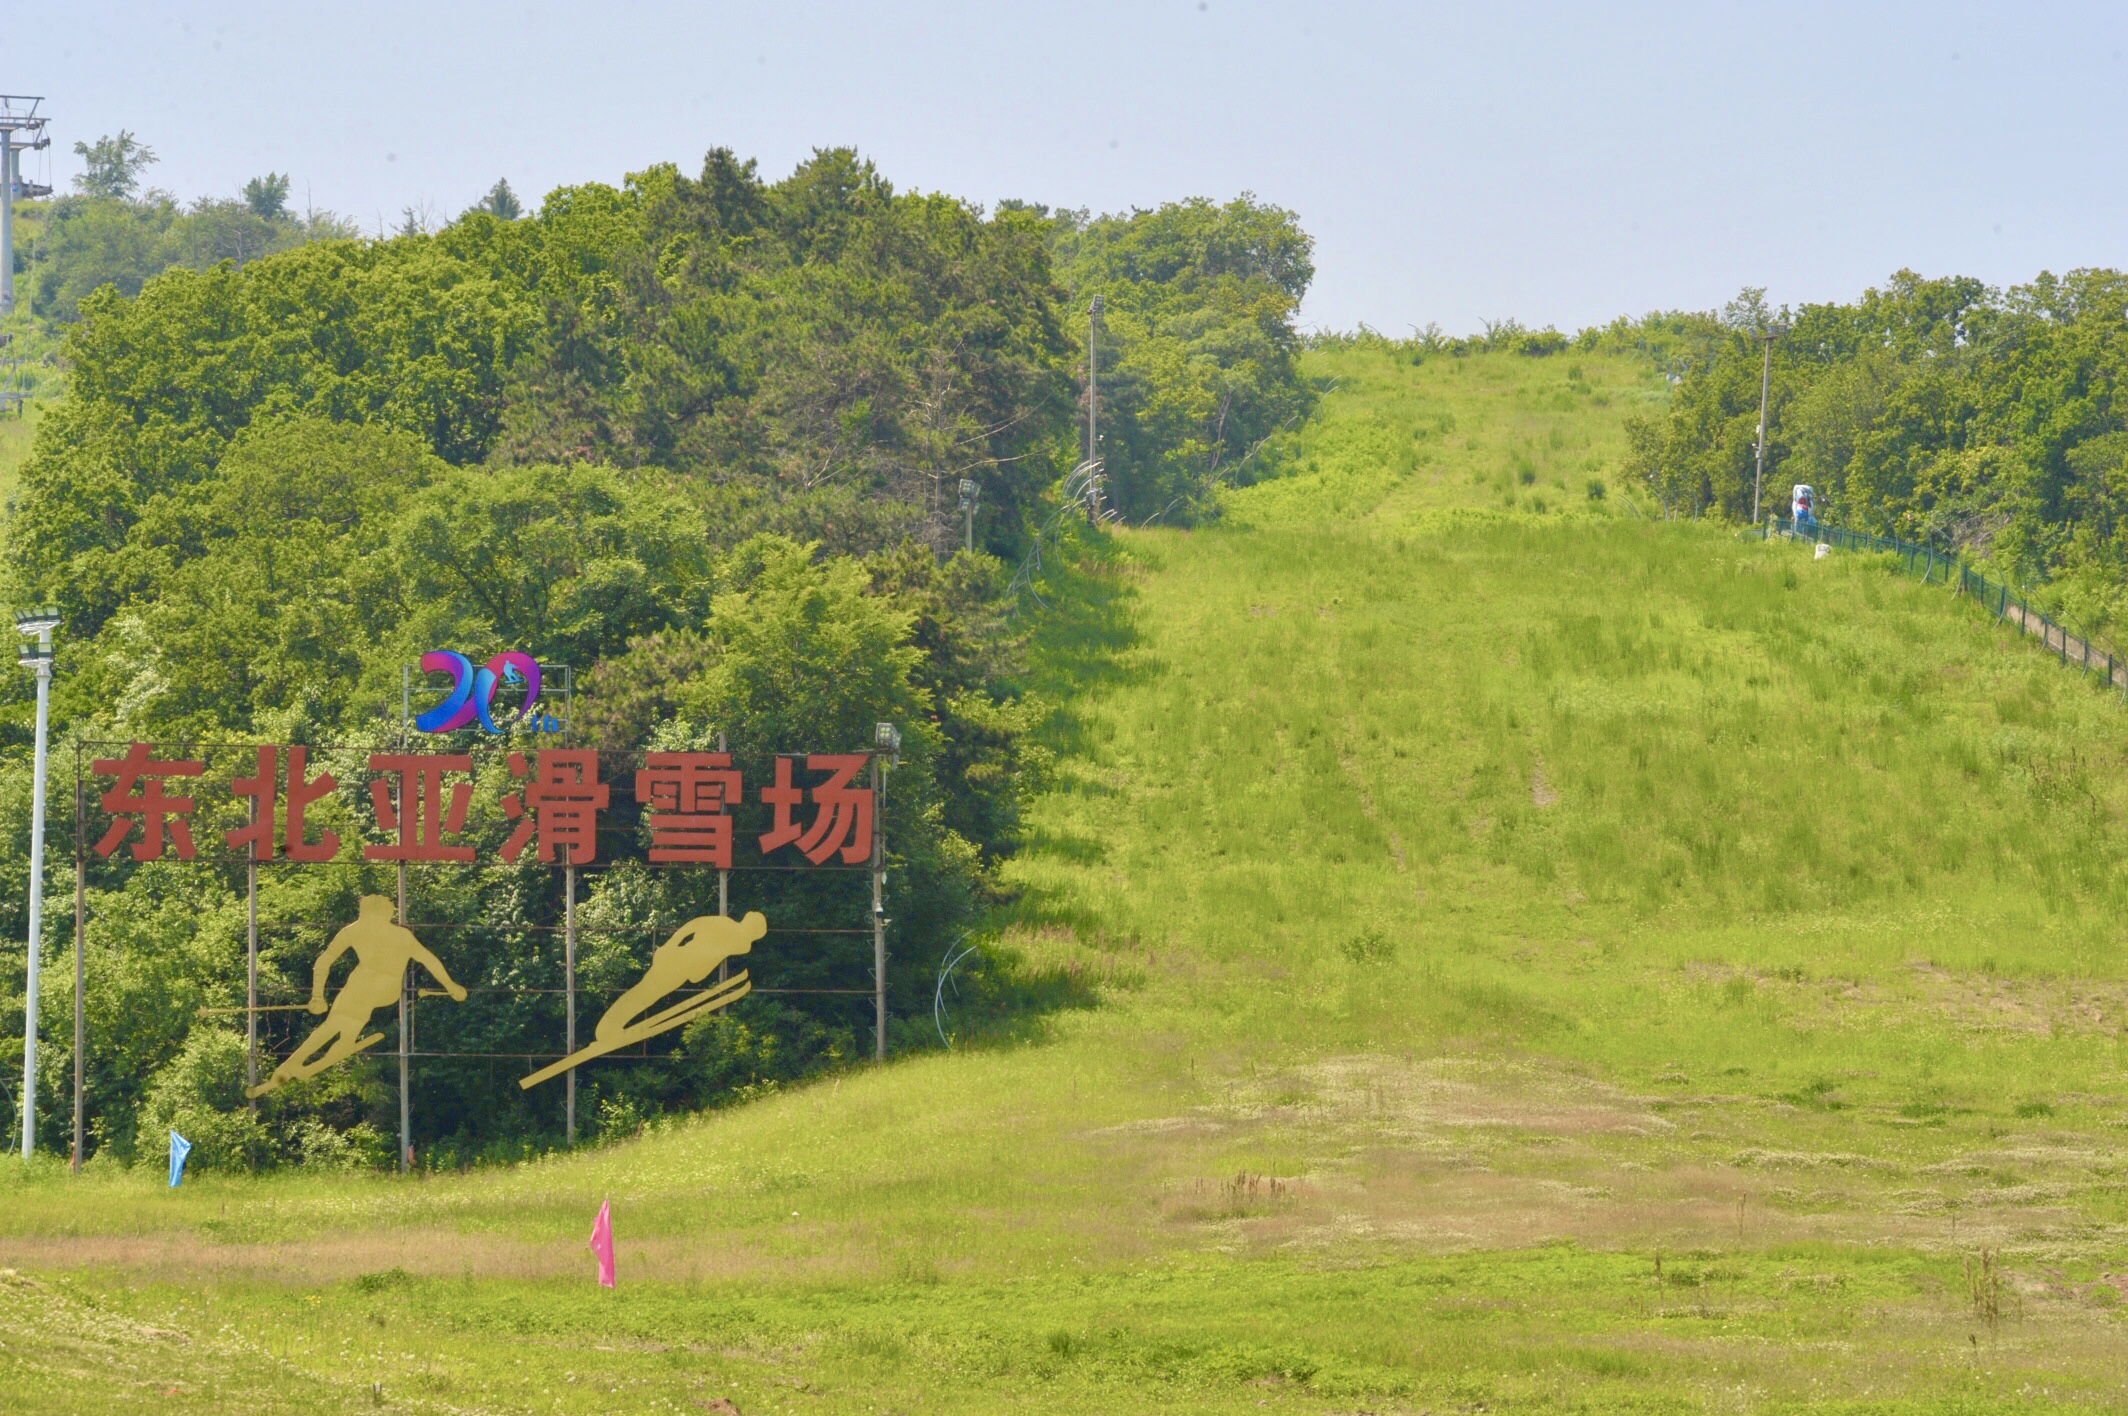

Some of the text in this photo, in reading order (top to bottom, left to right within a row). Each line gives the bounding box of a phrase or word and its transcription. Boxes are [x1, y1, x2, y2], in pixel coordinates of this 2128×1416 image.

[93, 742, 874, 868] 东北亚滑雪场
